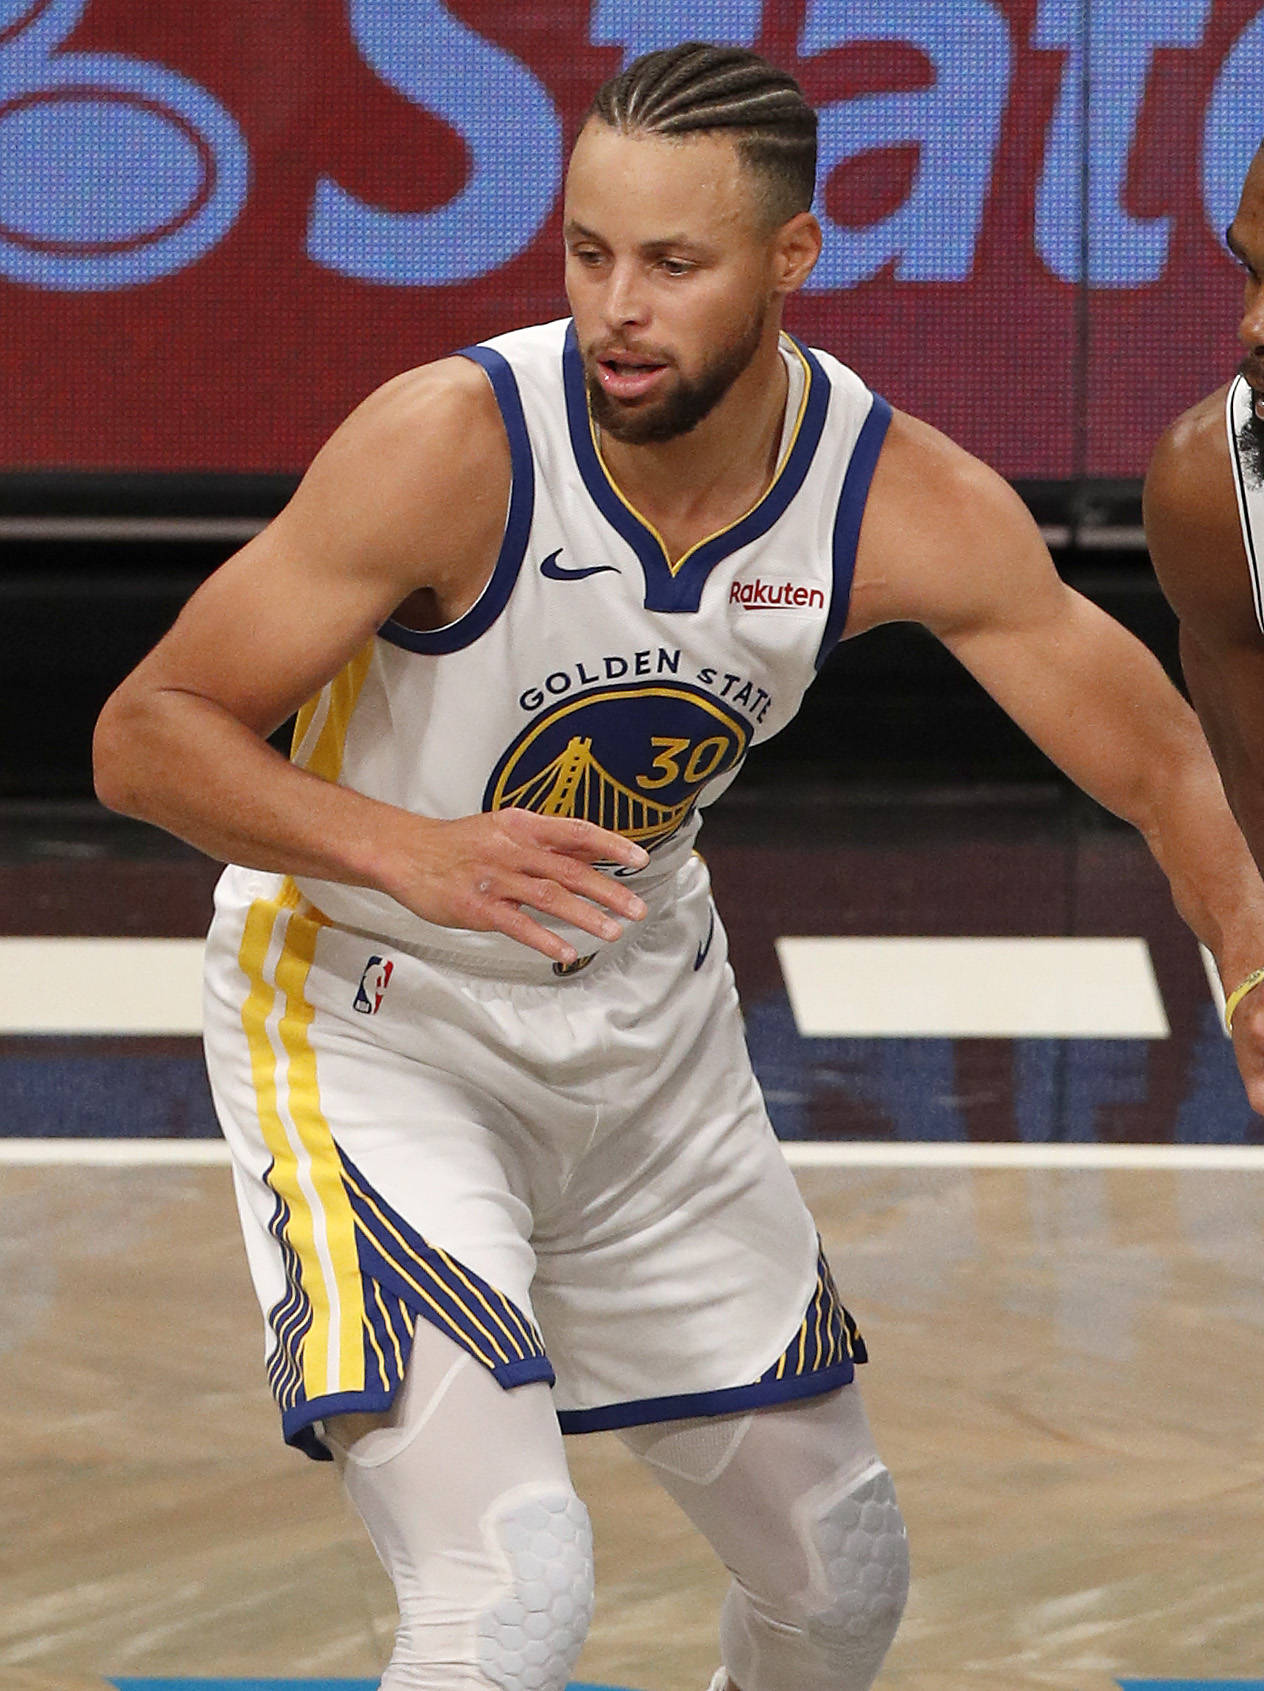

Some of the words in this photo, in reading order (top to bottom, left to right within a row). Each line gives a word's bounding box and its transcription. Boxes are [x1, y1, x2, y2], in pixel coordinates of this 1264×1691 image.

[729, 578, 825, 610] Rakuten
[519, 648, 681, 712] GOLDEN
[696, 667, 773, 725] STATE
[635, 736, 730, 790] 30
